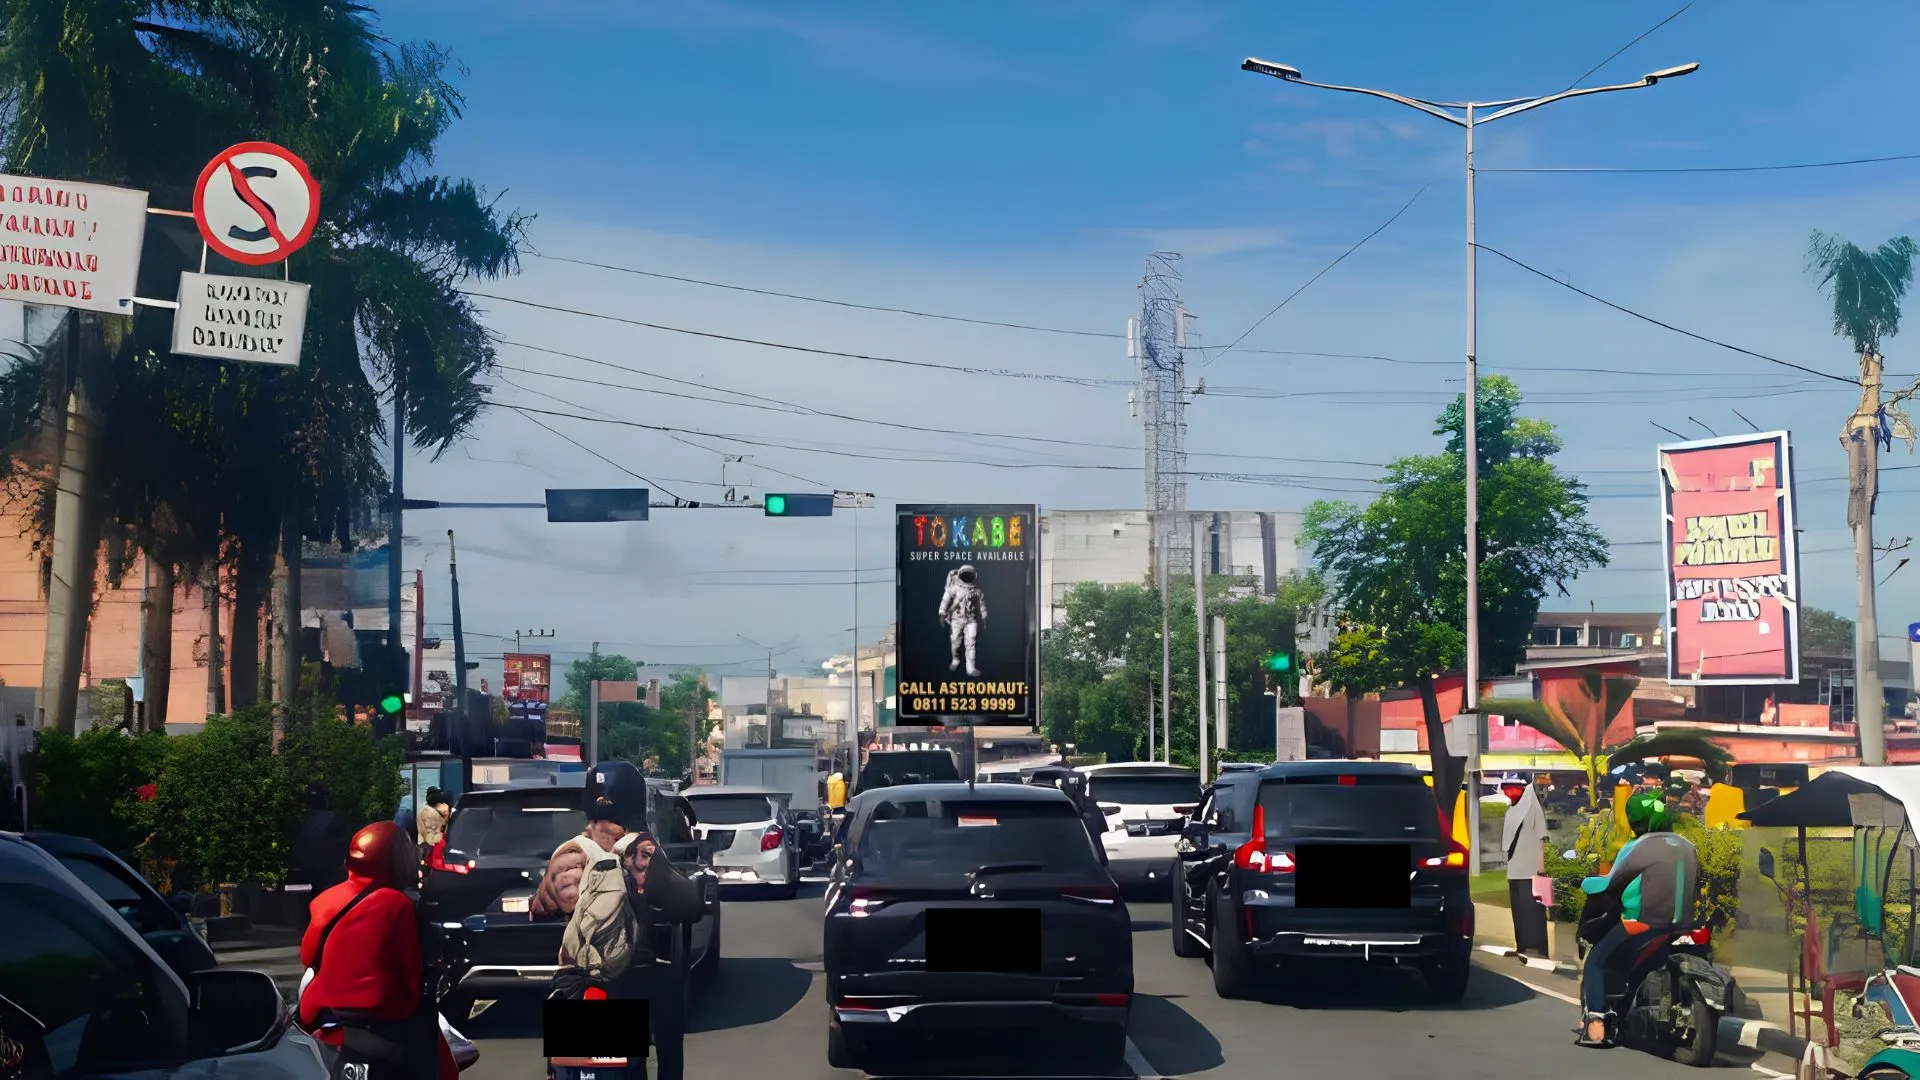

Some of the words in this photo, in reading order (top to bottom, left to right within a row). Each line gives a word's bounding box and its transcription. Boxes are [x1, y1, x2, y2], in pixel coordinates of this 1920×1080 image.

[913, 515, 1022, 548] TOKABE
[910, 551, 940, 561] SUPER
[944, 551, 973, 561] SPACE
[977, 551, 1025, 561] AVAILABLE
[899, 682, 935, 695] CALL
[939, 682, 1029, 695] ASTRONAUT:
[912, 697, 946, 711] 0811
[951, 697, 977, 711] 523
[981, 697, 1016, 711] 9999
